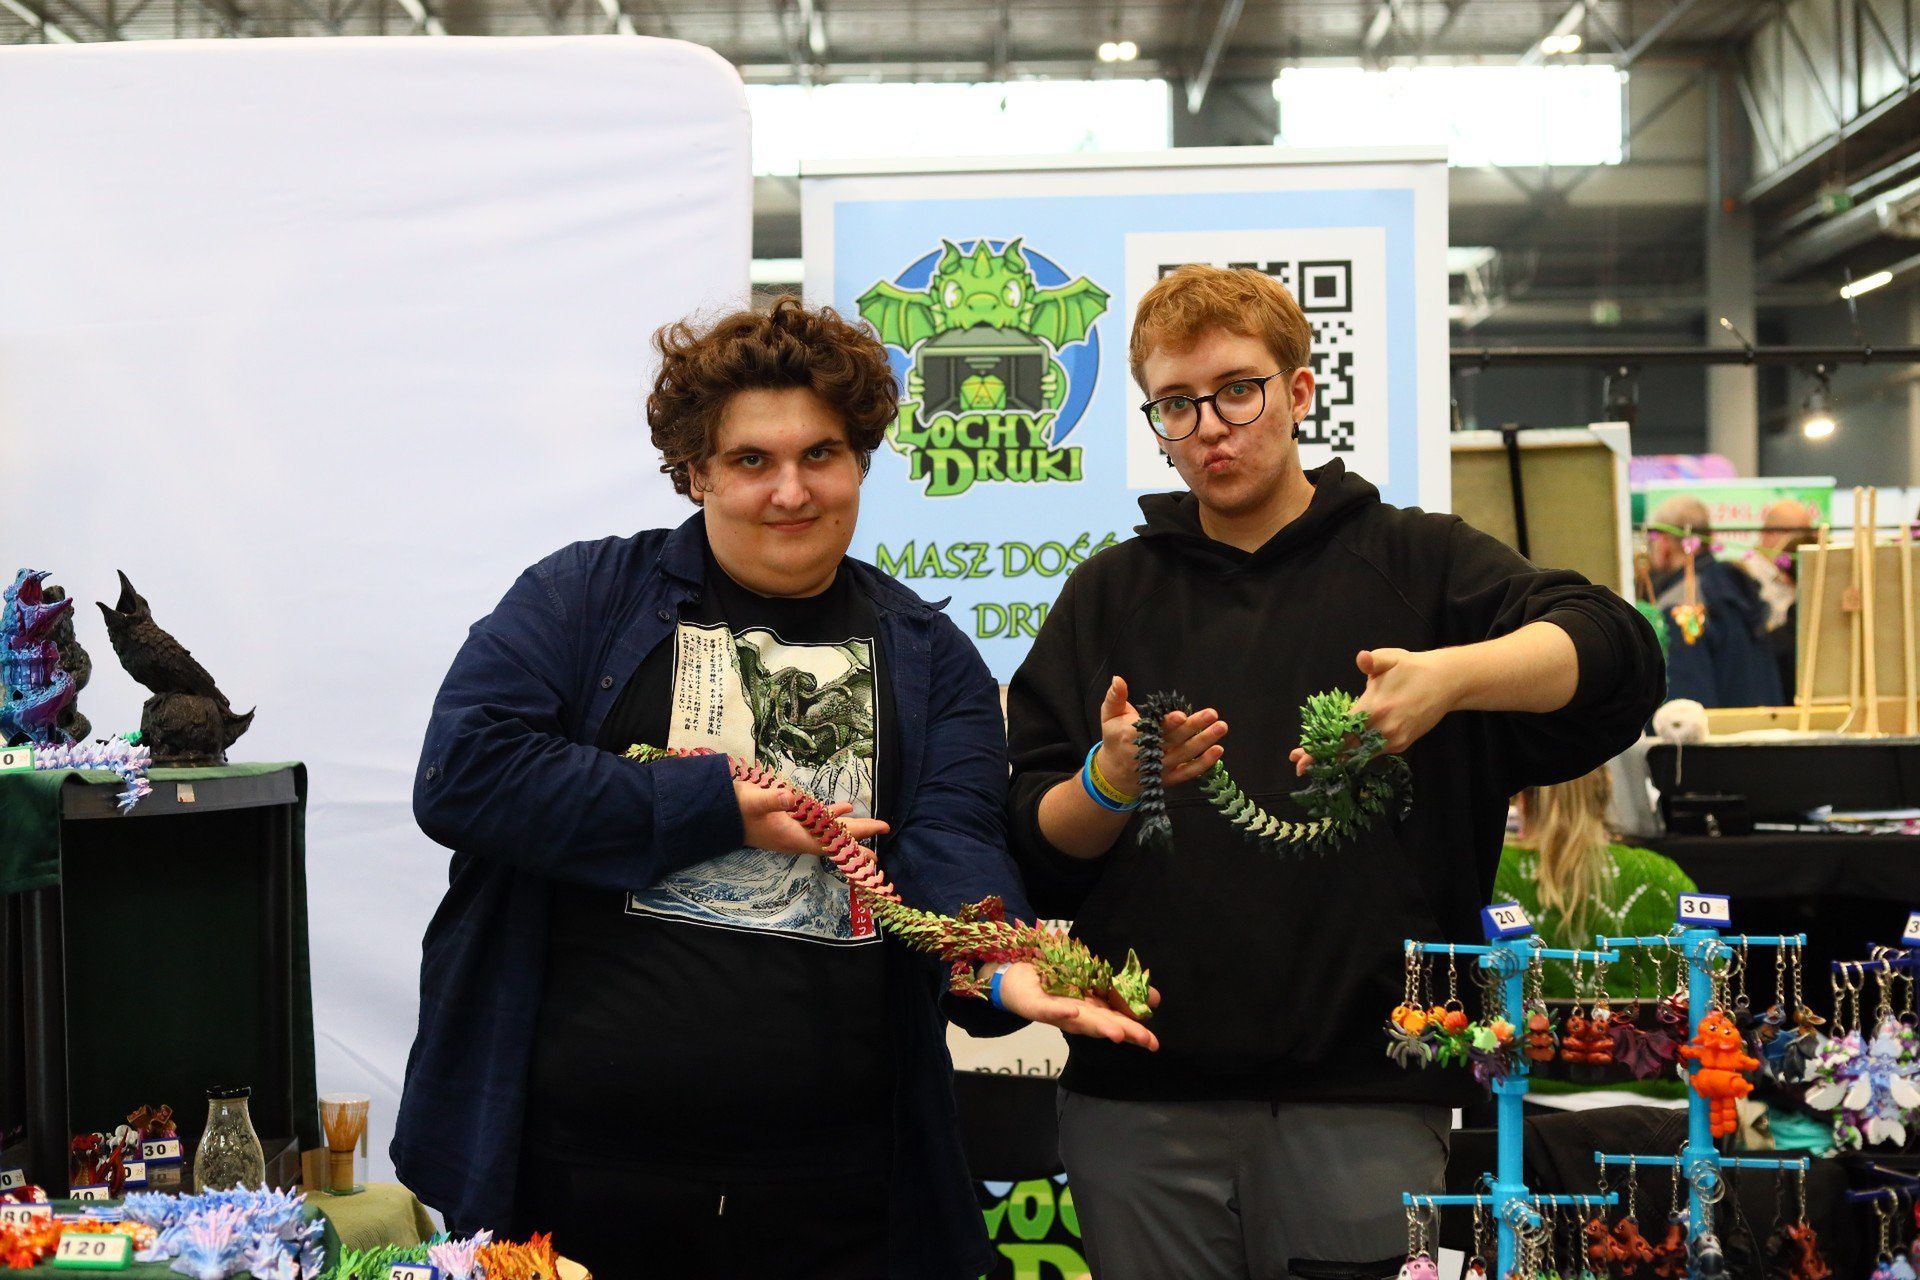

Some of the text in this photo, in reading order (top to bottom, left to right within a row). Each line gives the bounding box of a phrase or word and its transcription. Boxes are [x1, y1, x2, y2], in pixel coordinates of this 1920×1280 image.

[925, 447, 1084, 497] DRUKI
[1683, 899, 1711, 915] 30
[1495, 910, 1516, 925] 20
[144, 1144, 167, 1157] 30
[62, 1241, 106, 1257] 120
